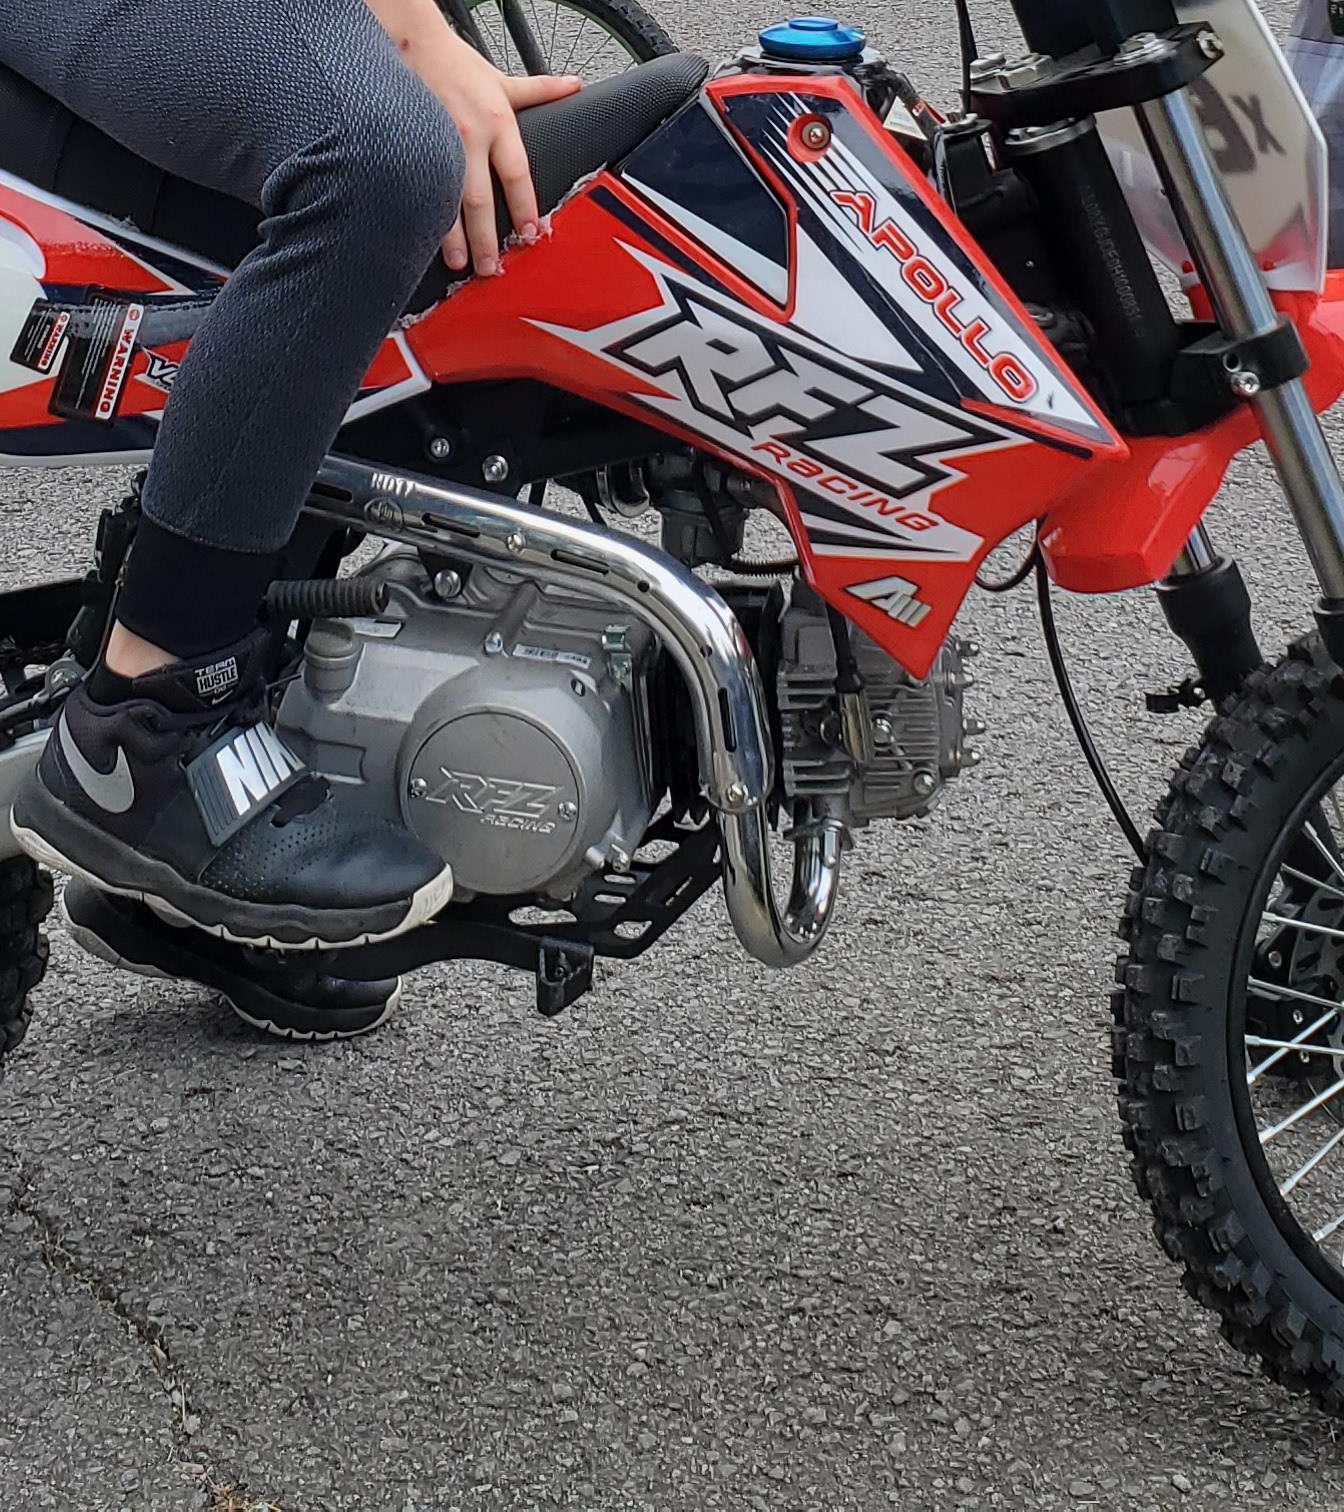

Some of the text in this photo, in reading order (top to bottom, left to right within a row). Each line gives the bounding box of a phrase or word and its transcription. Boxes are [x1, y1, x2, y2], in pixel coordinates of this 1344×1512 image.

[830, 190, 1038, 403] APOLLO
[608, 284, 994, 495] RFZ
[751, 440, 940, 533] RACING
[216, 721, 306, 816] NIK
